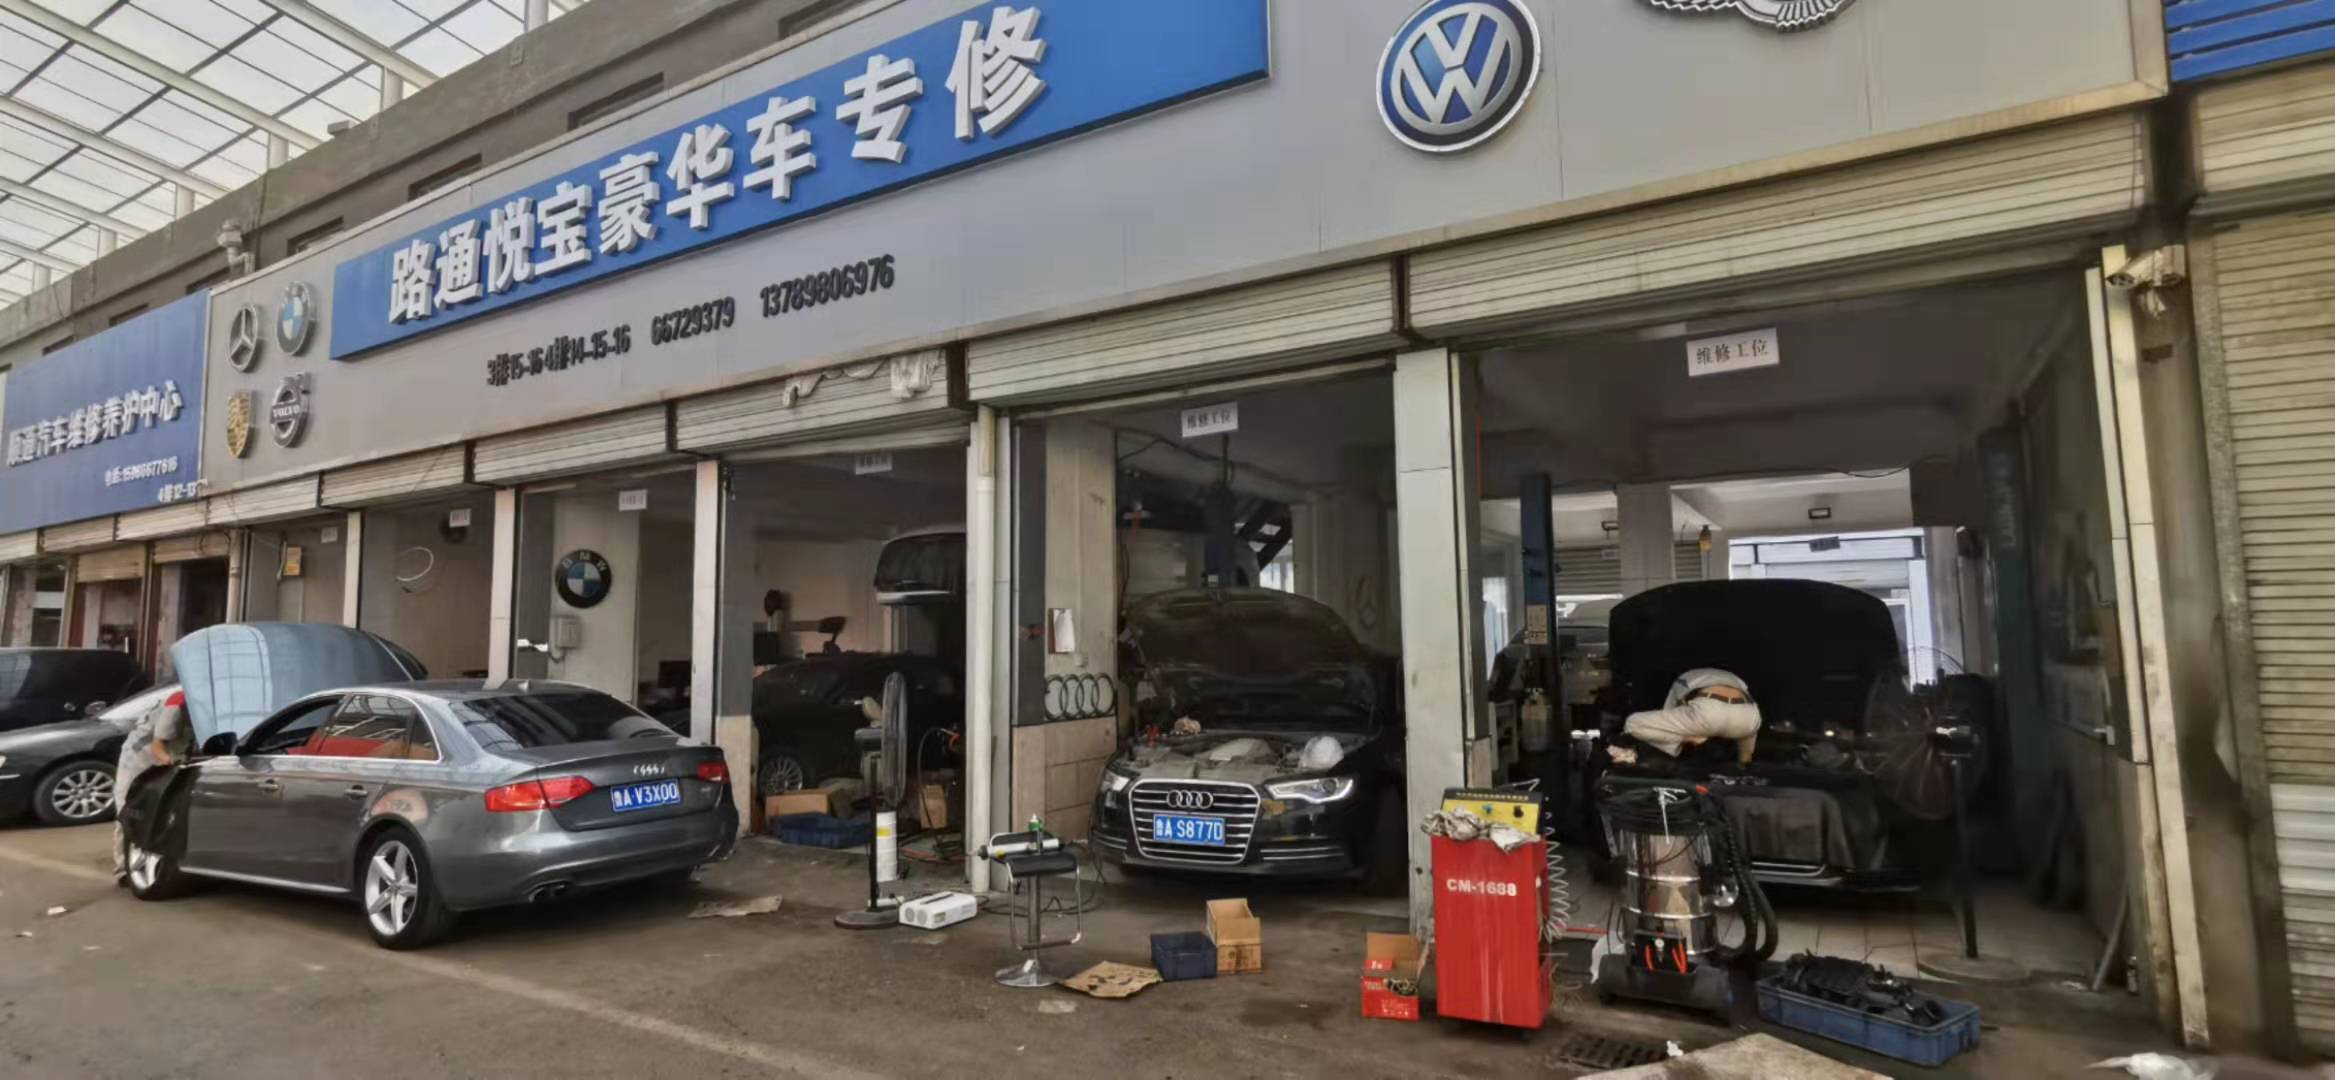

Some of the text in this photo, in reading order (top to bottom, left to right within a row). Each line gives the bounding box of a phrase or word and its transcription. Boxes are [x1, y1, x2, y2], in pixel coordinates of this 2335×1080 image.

[388, 5, 1048, 325] 路通悦宝豪华车专修
[651, 296, 735, 345] 66729379
[760, 253, 895, 318] 13789806976
[1446, 878, 1518, 897] CM-1688
